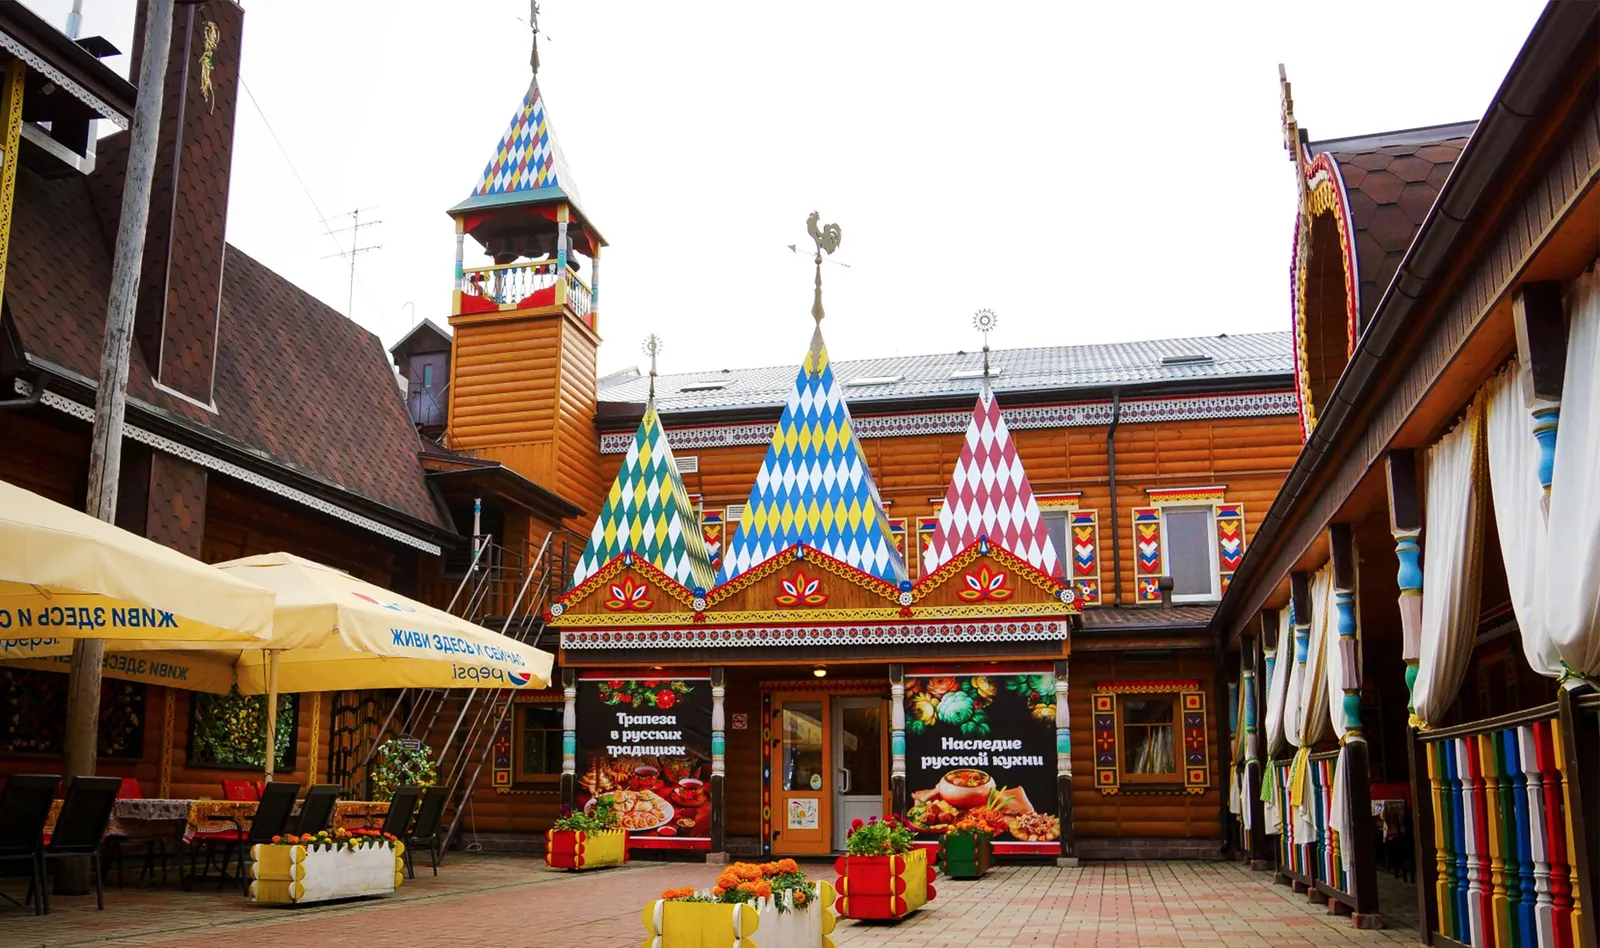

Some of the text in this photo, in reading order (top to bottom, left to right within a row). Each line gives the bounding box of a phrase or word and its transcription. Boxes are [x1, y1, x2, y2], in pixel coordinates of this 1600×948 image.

[390, 628, 431, 649] ЖИВИ
[433, 634, 474, 655] ЗДЕСЬ
[484, 645, 526, 667] СЕЙЧАС
[616, 712, 677, 727] Трапеза
[610, 730, 682, 743] в русских
[606, 745, 686, 758] традициях
[941, 737, 1022, 752] Наследие
[921, 752, 1044, 769] русской кухни
